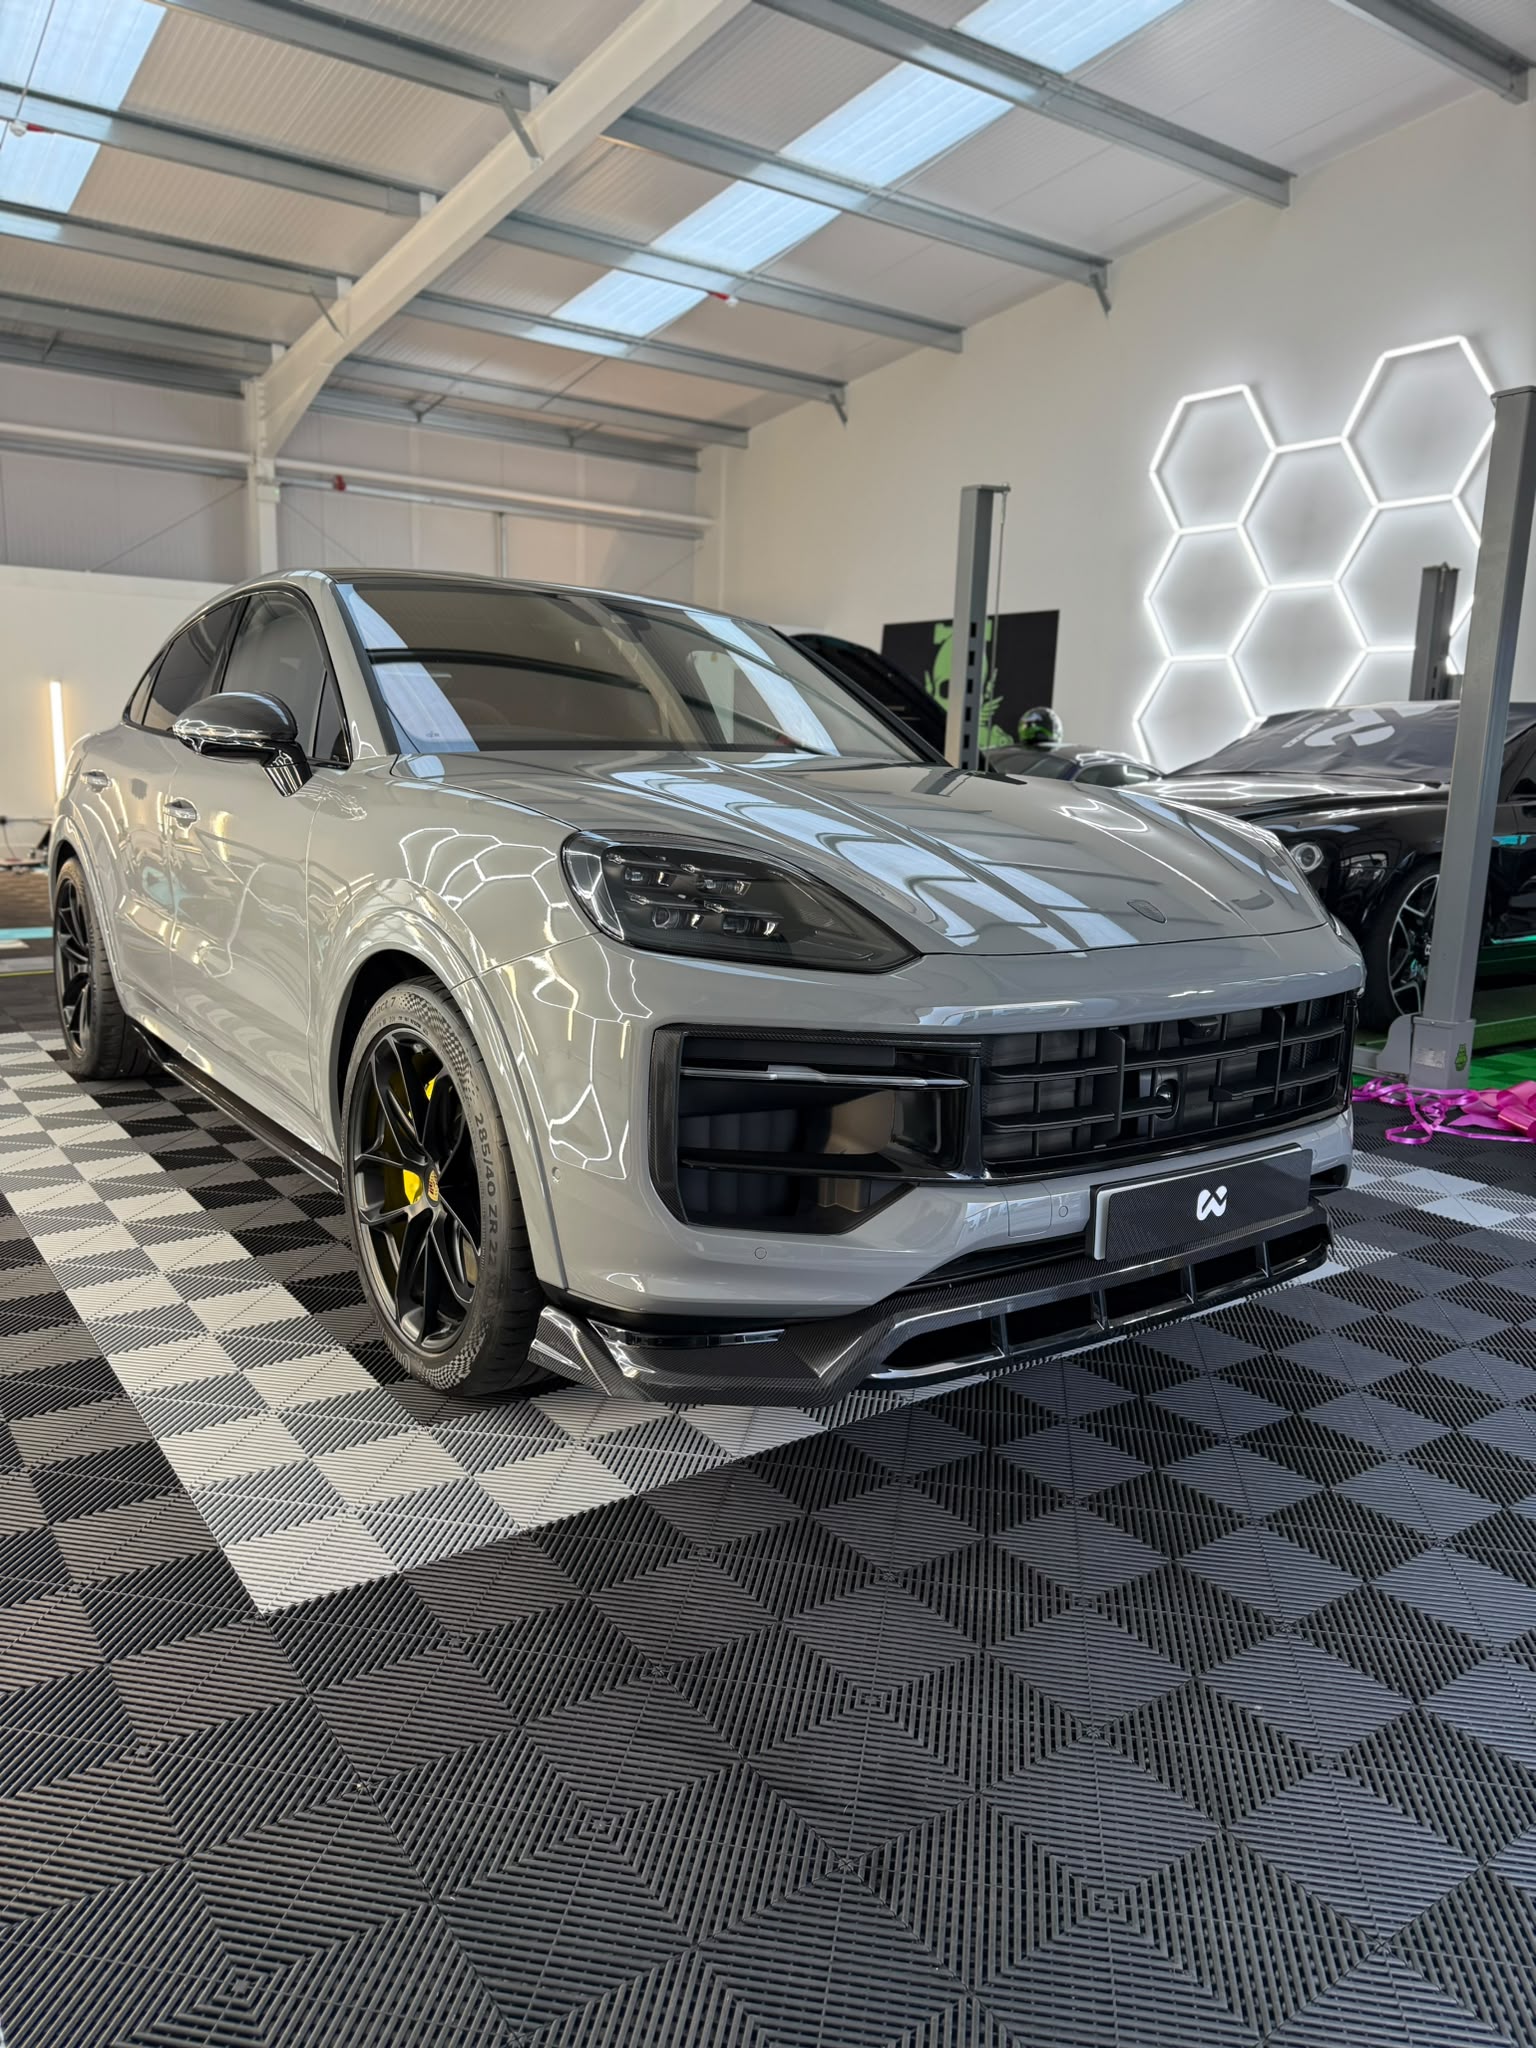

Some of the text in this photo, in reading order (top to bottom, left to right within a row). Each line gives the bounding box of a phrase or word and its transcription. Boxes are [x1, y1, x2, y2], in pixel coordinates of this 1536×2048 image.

[390, 996, 397, 1007] 7
[474, 1112, 496, 1197] 285/40
[488, 1203, 499, 1234] ZR
[488, 1240, 499, 1265] 22
